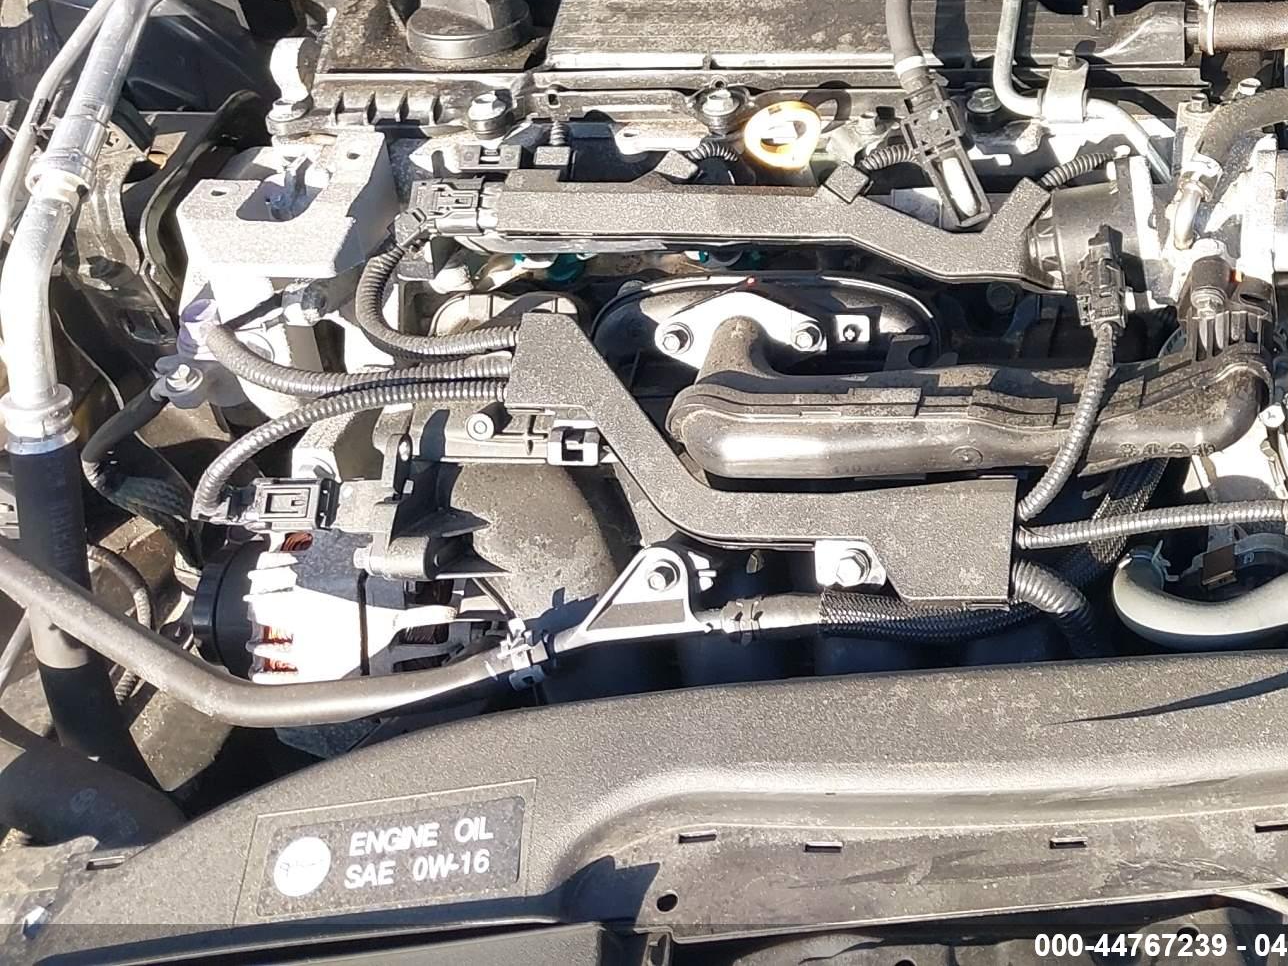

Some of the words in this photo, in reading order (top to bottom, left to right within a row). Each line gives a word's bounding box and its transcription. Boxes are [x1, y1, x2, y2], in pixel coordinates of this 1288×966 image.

[349, 821, 441, 857] ENGINE
[454, 816, 494, 843] OIL
[344, 860, 397, 890] SAE
[412, 849, 491, 882] 0W-16
